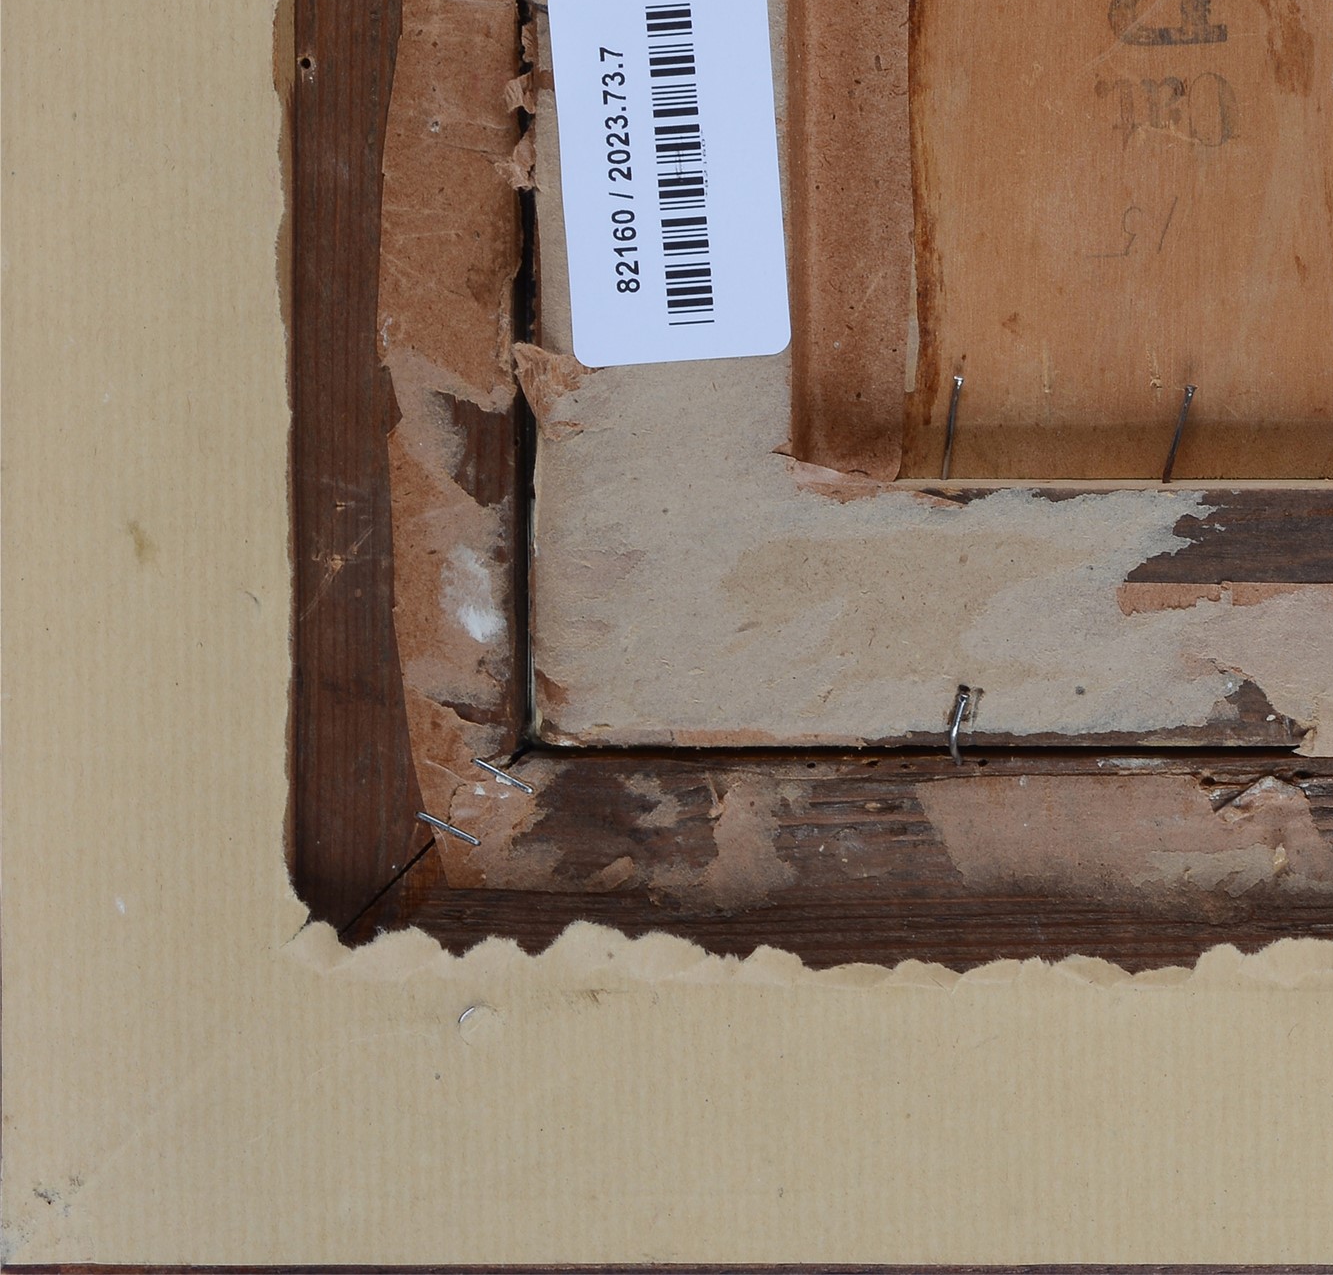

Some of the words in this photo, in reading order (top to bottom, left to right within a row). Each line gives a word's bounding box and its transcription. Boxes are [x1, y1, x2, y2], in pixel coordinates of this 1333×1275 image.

[599, 47, 633, 182] 2023.73.7
[609, 191, 635, 200] /
[610, 210, 642, 294] 82160
